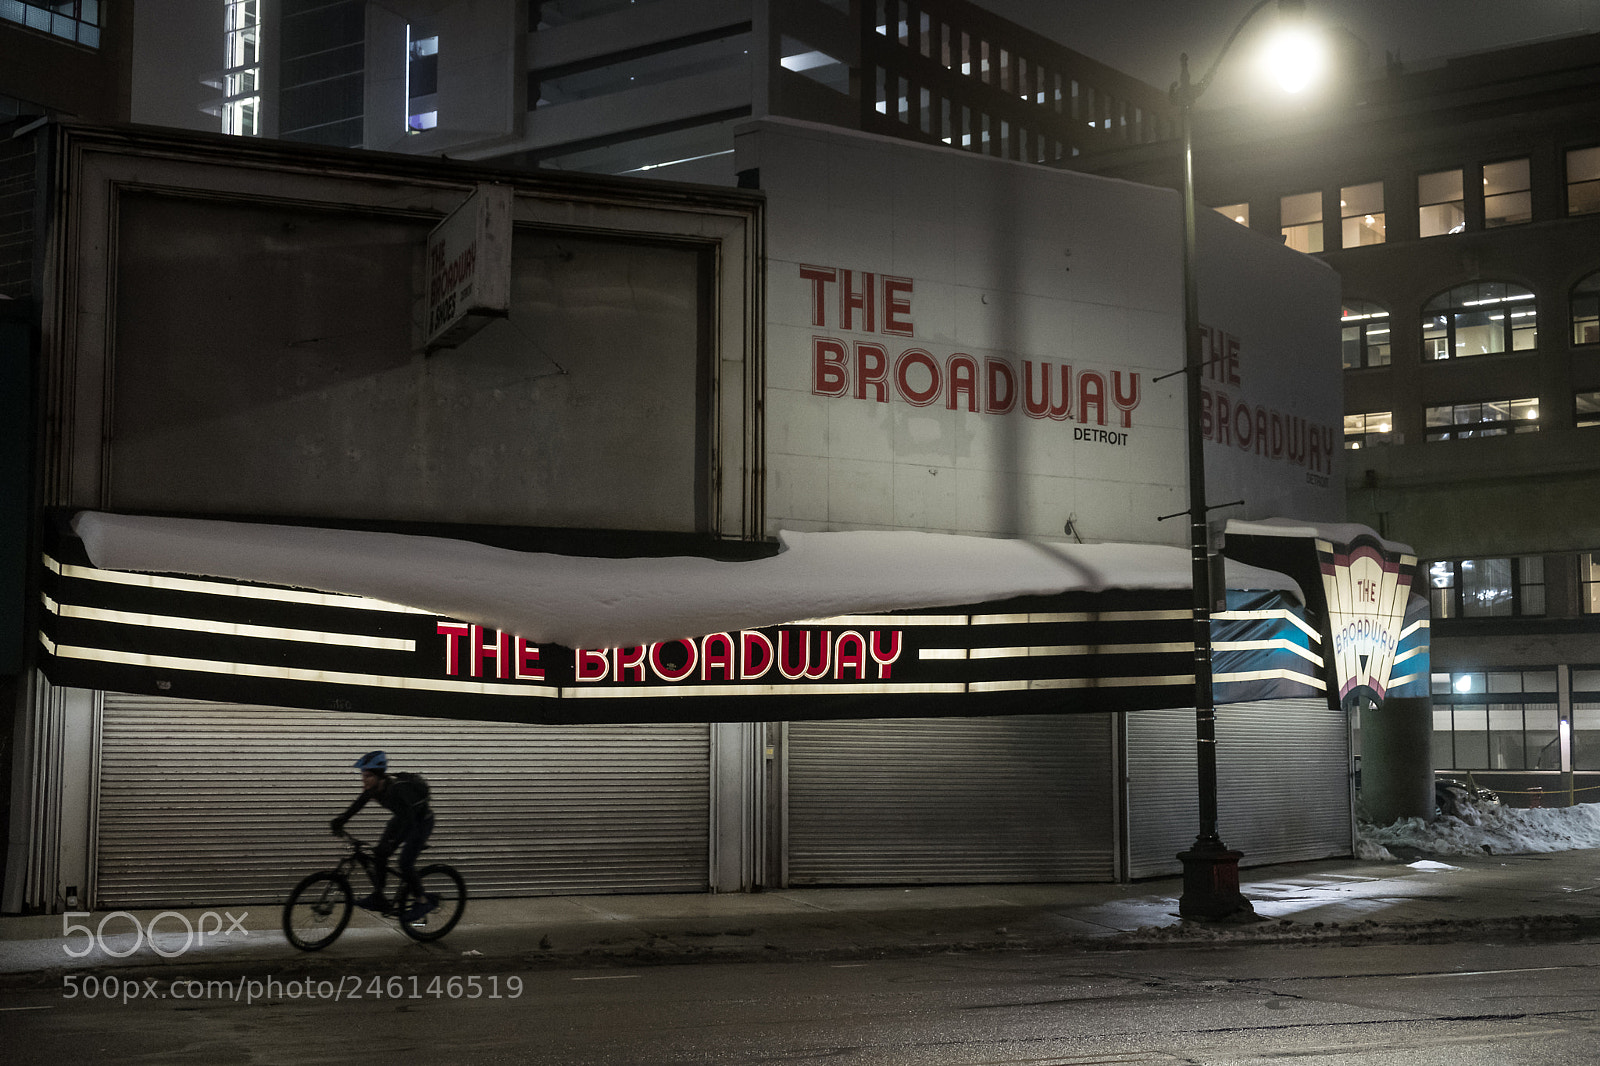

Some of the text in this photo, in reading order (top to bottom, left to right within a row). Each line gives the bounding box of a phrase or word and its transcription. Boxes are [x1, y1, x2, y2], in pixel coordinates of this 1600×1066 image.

[430, 239, 477, 307] BROADWAY
[431, 239, 446, 276] THE
[799, 263, 914, 337] THE
[811, 335, 1142, 428] BROADWAY
[1199, 324, 1241, 387] THE
[1073, 427, 1129, 446] DETROIT
[1200, 385, 1333, 476] BROADWAY
[1357, 578, 1377, 603] THE
[437, 621, 903, 682] THE BROADWAY
[1335, 618, 1396, 659] BROADWAY
